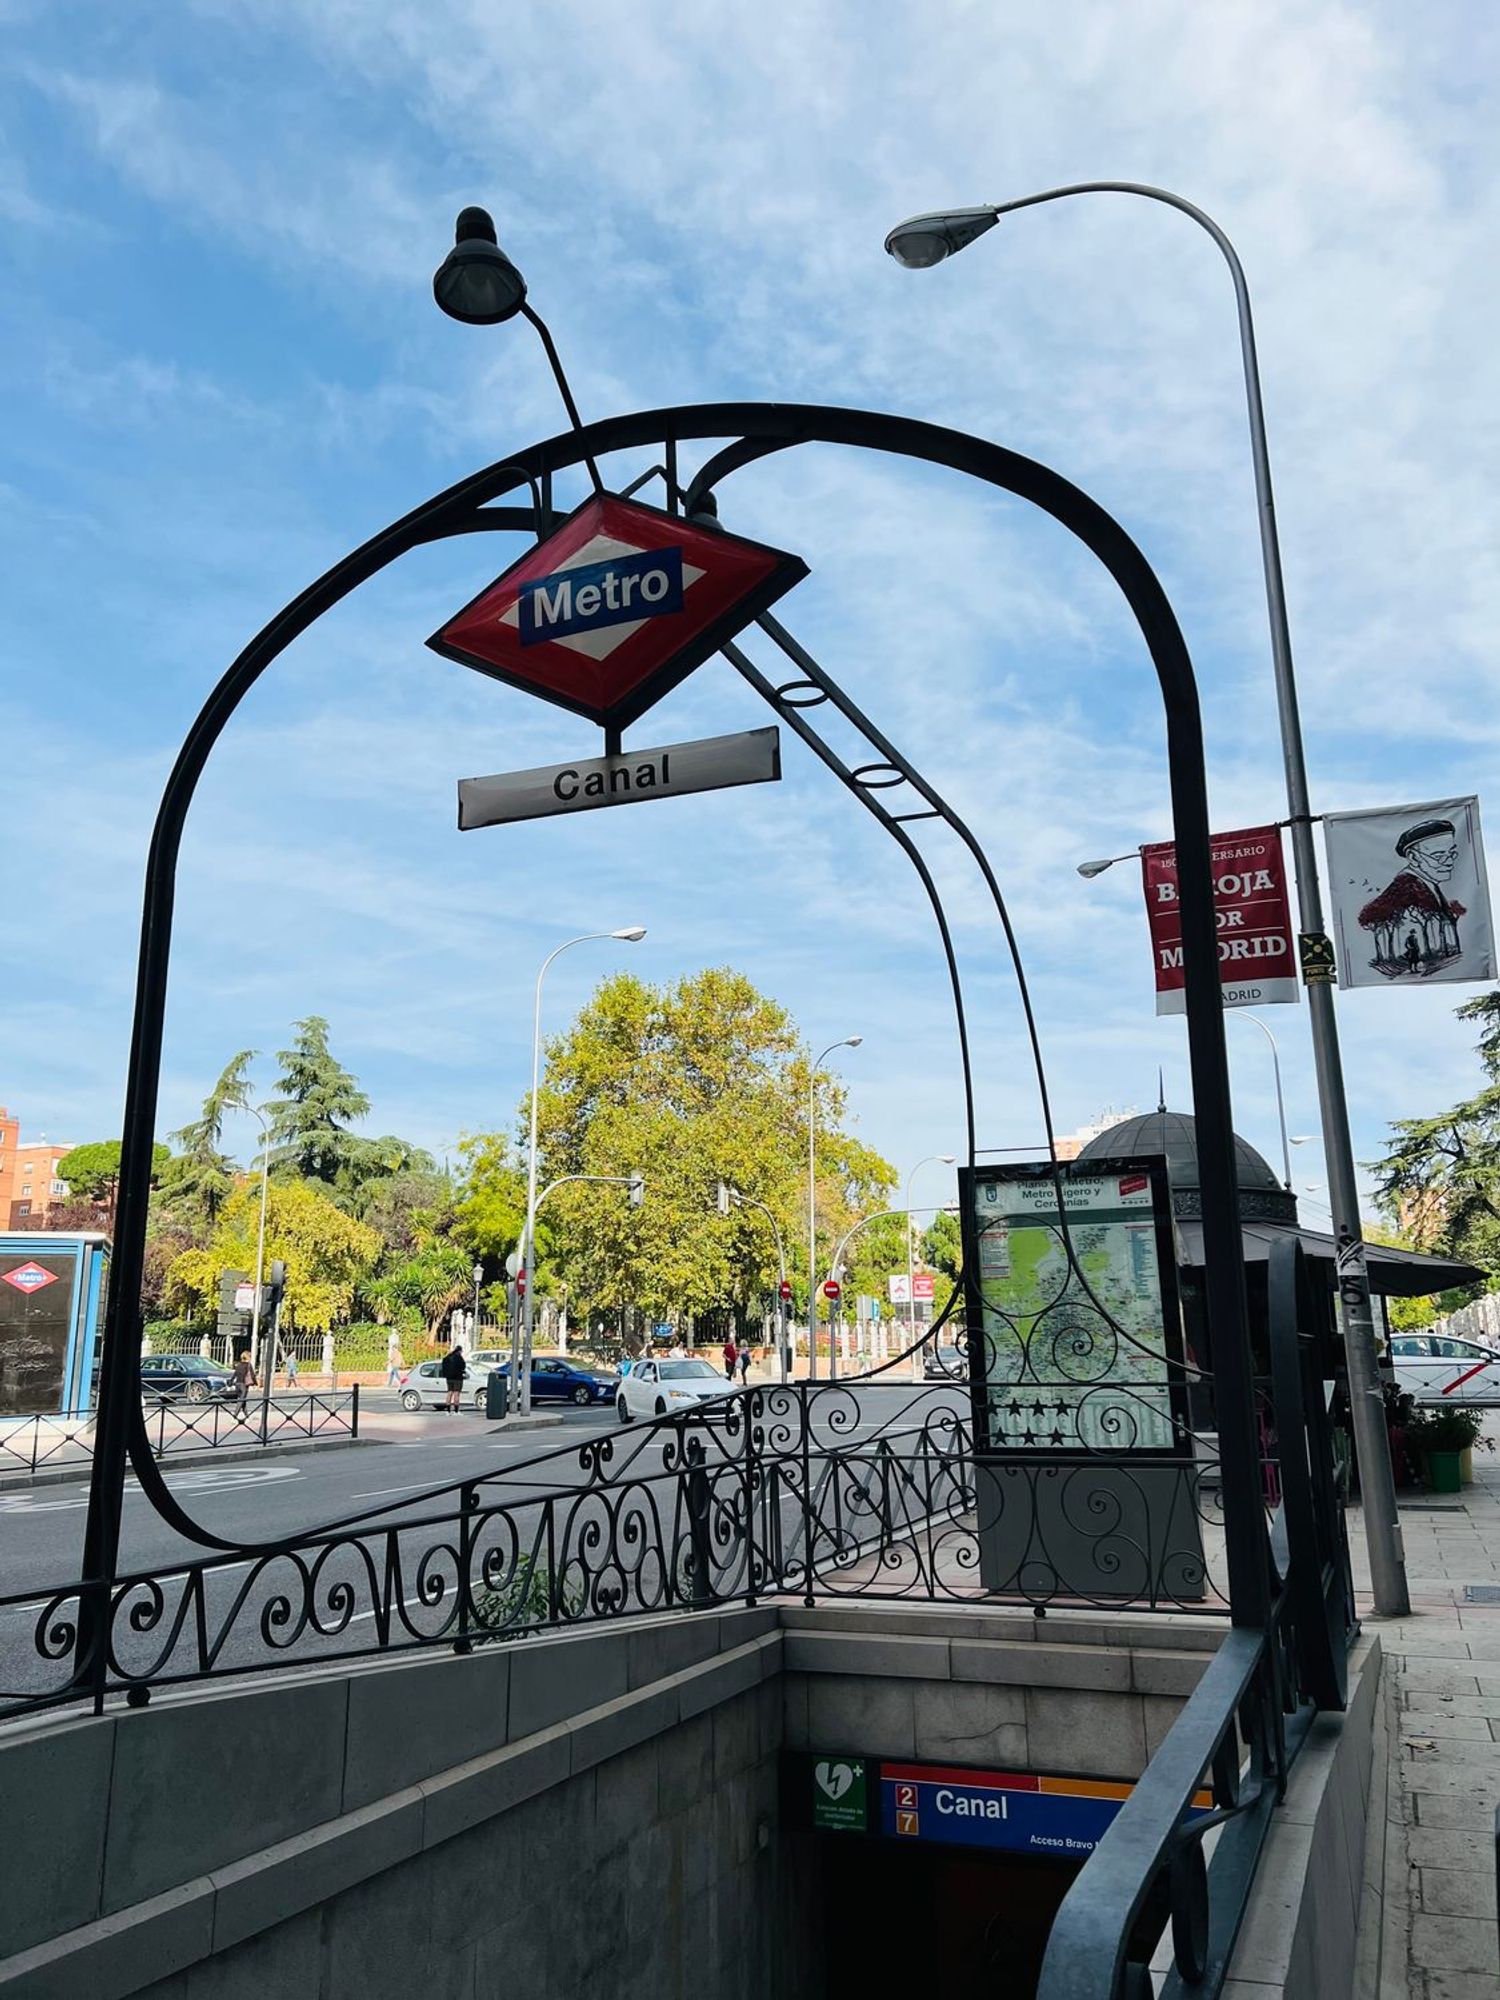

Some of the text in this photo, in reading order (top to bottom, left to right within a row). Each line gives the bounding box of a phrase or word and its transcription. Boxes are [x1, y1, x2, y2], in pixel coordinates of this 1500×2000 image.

[534, 569, 669, 628] Metro
[553, 754, 670, 801] Canal
[1211, 845, 1266, 861] ERSARIO
[1156, 869, 1275, 903] BOJA
[1160, 935, 1288, 970] MDRID
[1220, 988, 1262, 1002] ADRID
[1022, 1190, 1054, 1199] Metro
[1063, 1188, 1092, 1198] igero
[901, 1787, 1008, 1820] 2 Canal
[901, 1814, 913, 1832] 7
[1030, 1834, 1064, 1847] Acceso
[1065, 1838, 1094, 1850] Bravo
